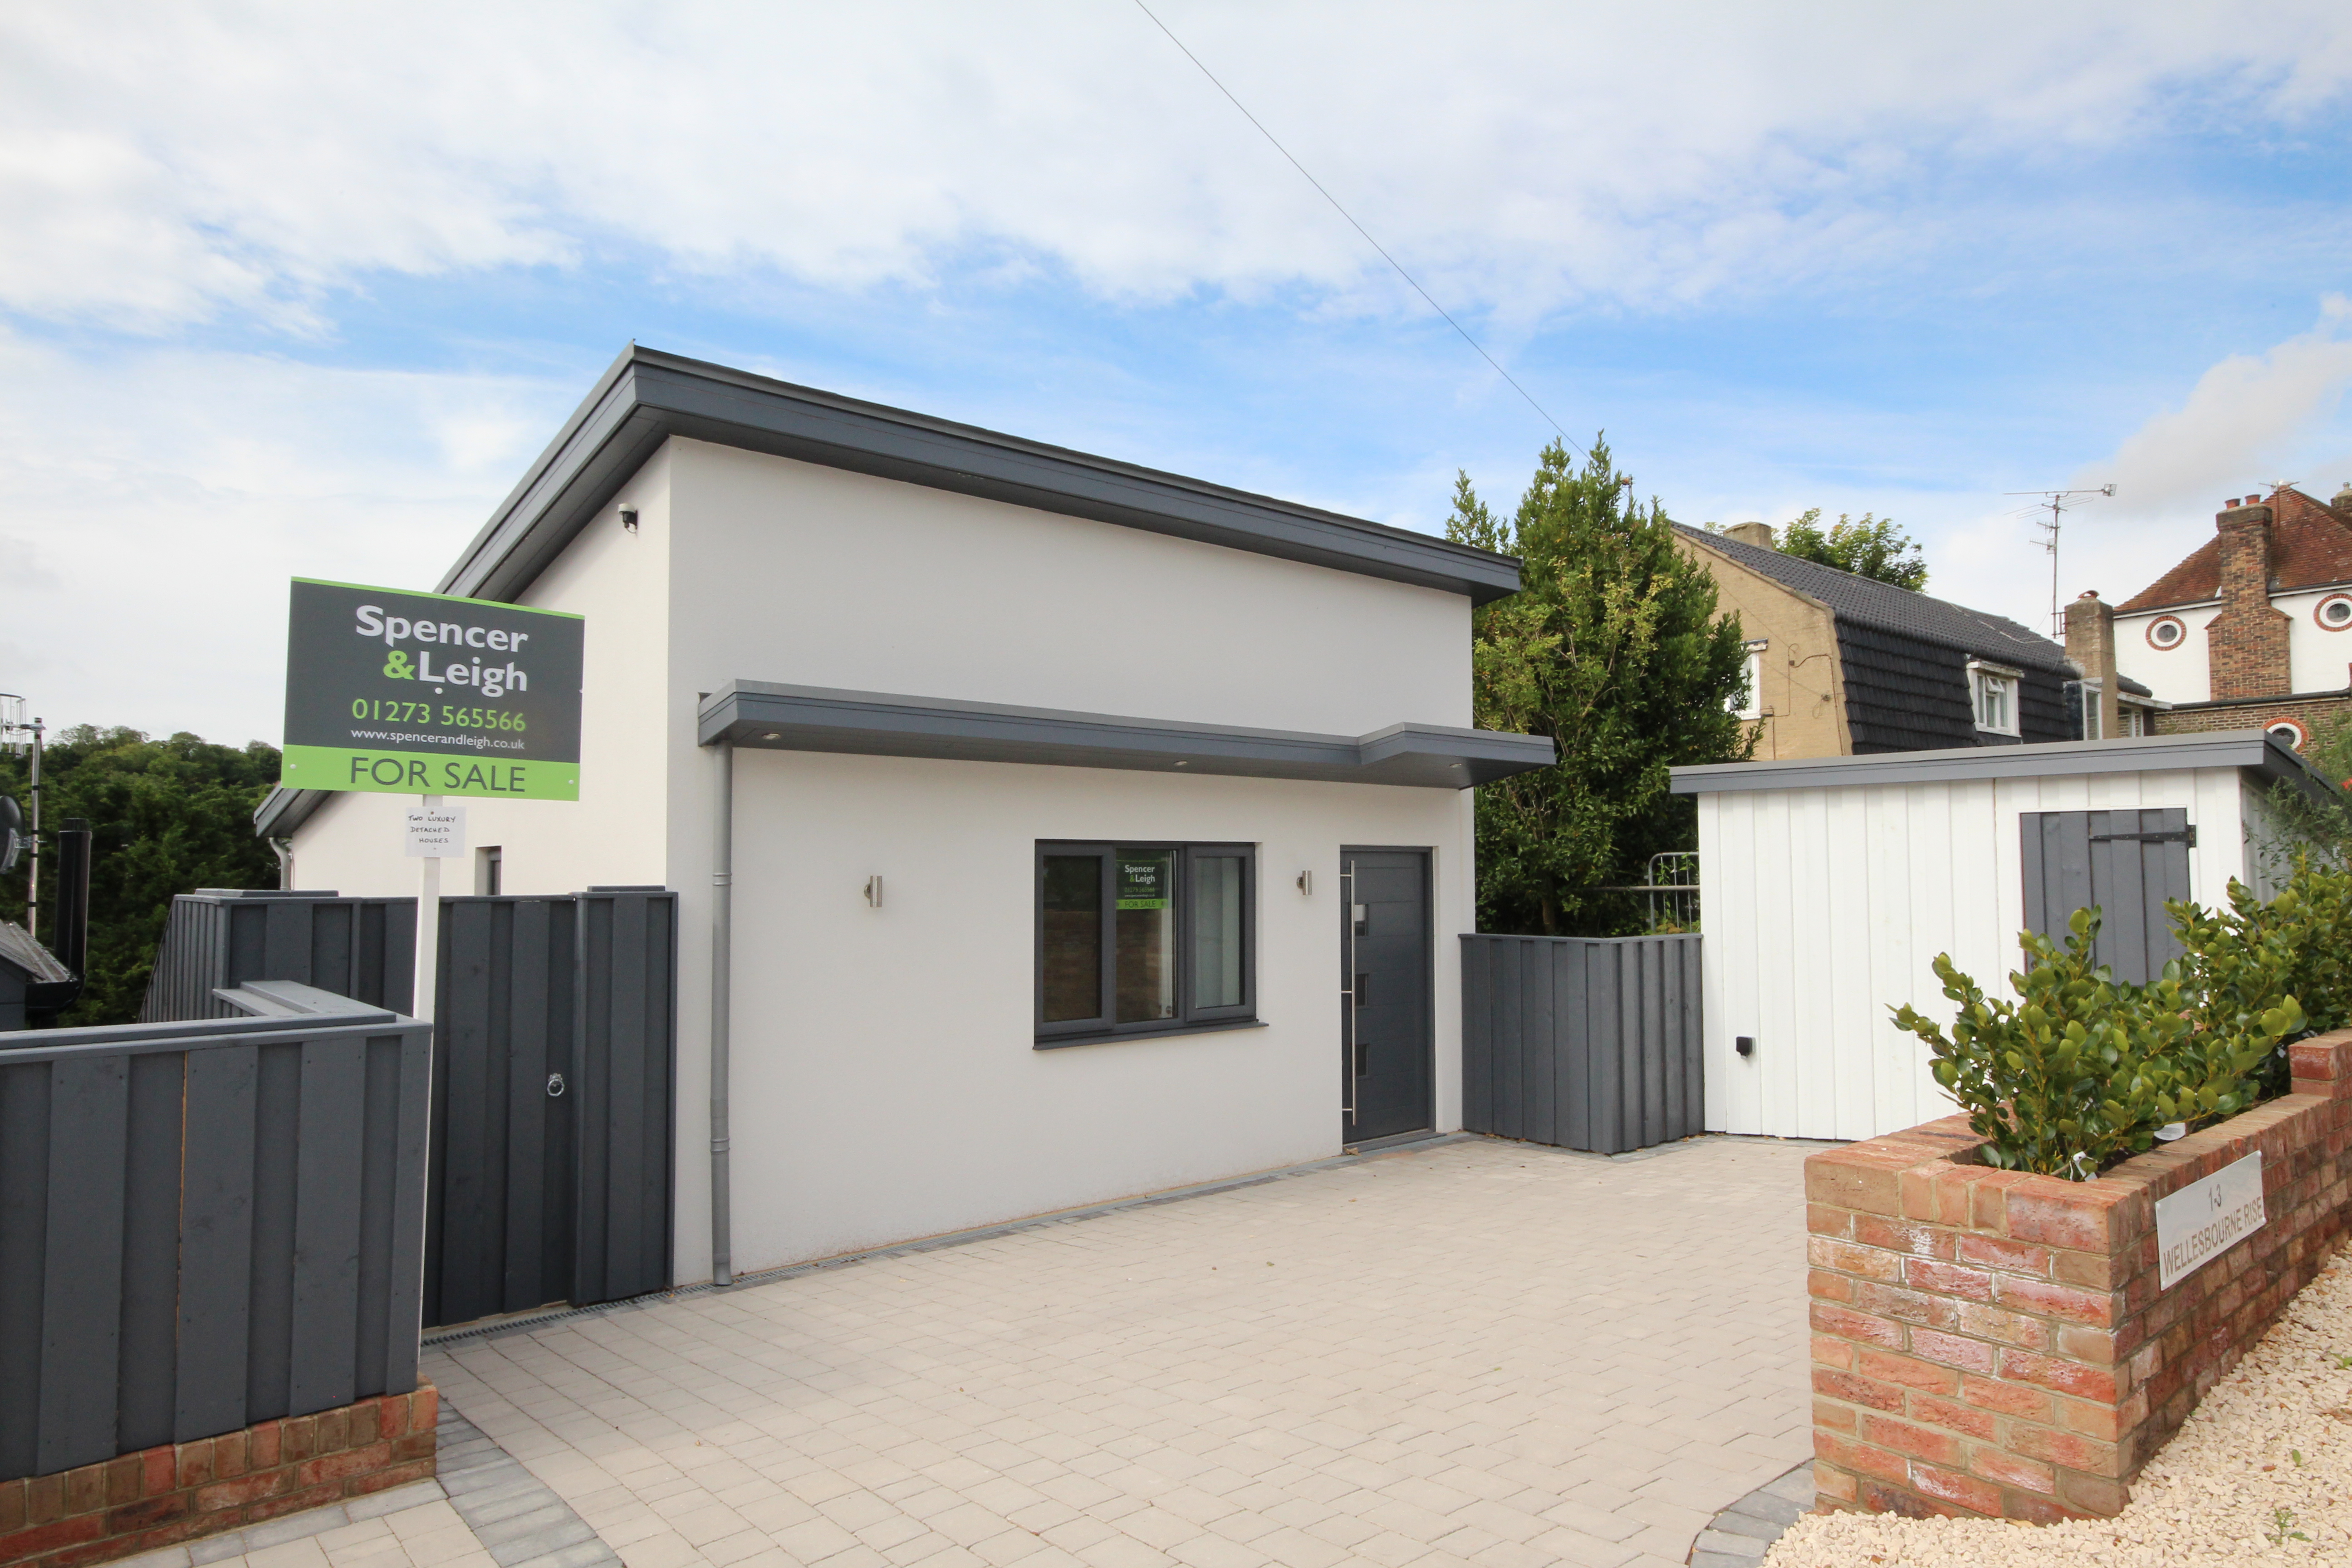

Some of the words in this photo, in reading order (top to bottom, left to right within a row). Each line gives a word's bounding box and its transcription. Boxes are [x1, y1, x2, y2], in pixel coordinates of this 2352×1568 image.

[356, 605, 528, 652] Spencer
[352, 698, 430, 724] 01273
[441, 705, 525, 731] 565566
[351, 730, 525, 750] www.spencerandleigh.co.uk
[351, 757, 431, 787] FOR
[444, 762, 525, 792] SALE
[1125, 865, 1155, 874] Spencer
[2208, 1184, 2221, 1211] 1-3
[2164, 1208, 2242, 1277] WELLESBOURNE
[2244, 1196, 2262, 1227] RISE
